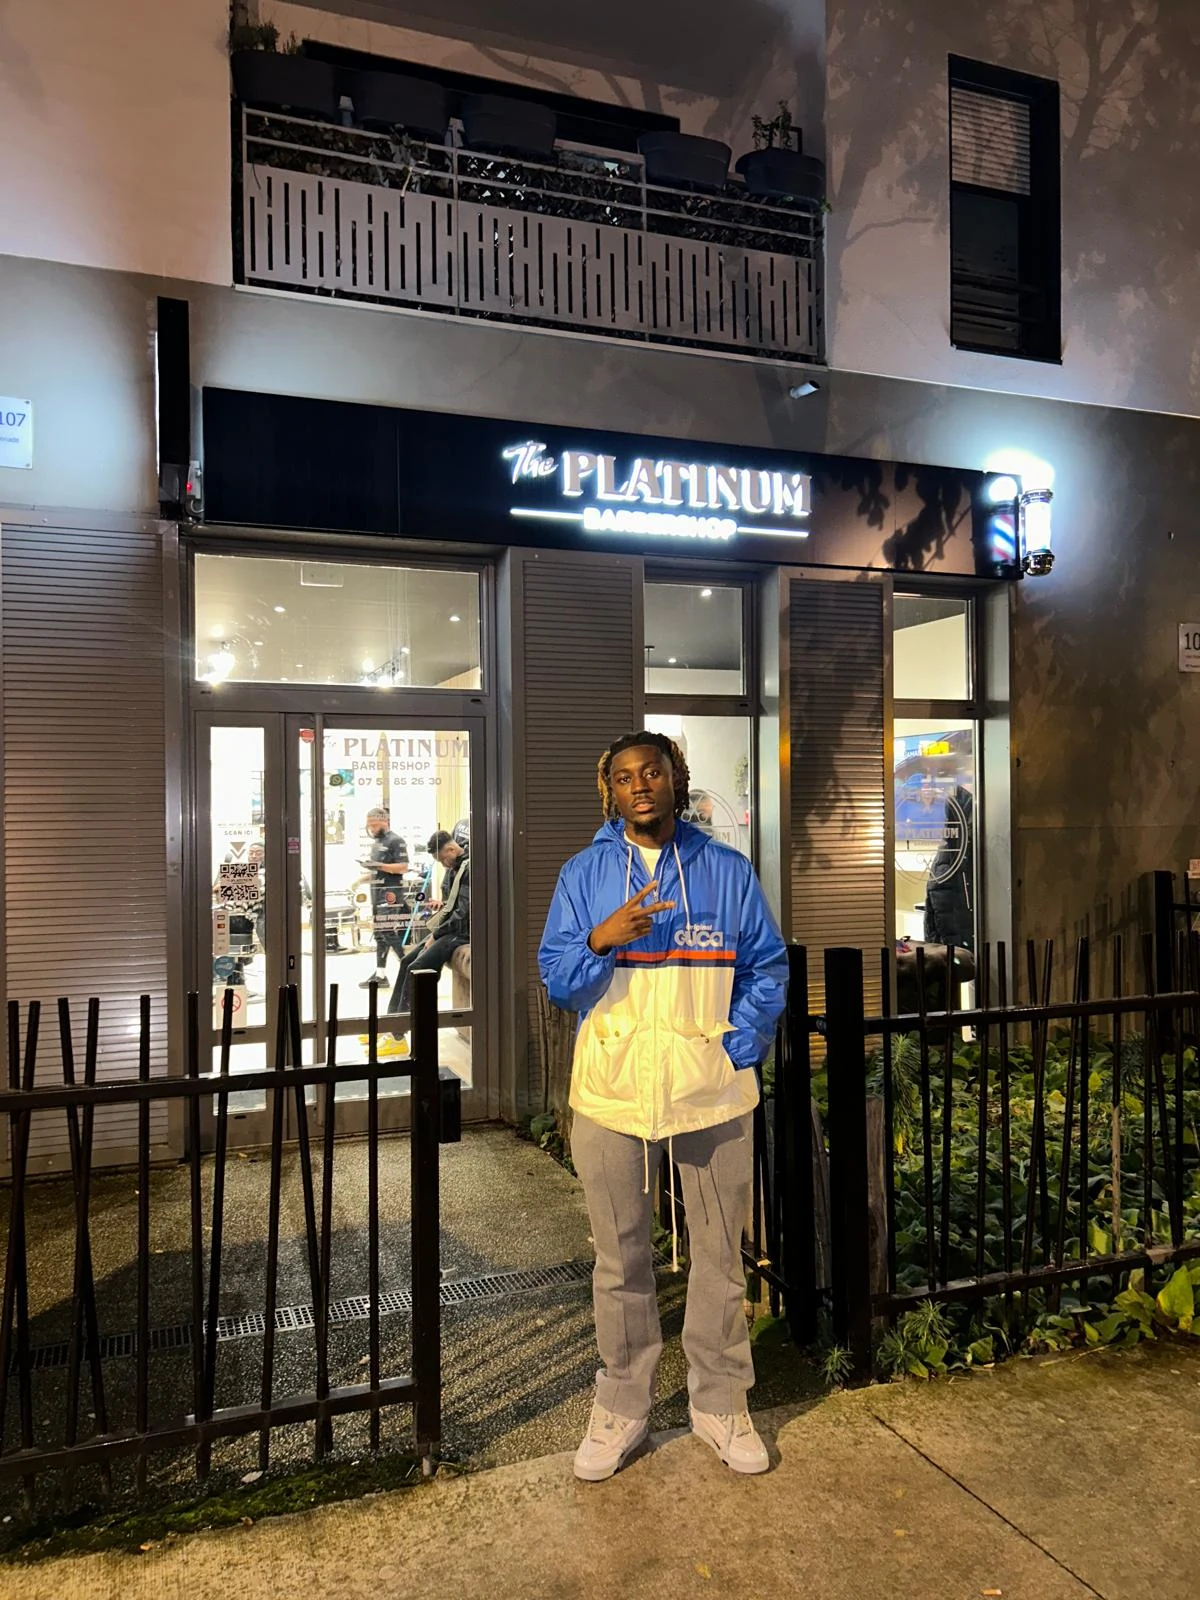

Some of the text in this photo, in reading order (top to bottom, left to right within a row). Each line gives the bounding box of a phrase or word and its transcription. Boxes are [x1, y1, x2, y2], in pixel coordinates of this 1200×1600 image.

[502, 439, 812, 516] The PLATINUM
[343, 737, 469, 759] PLATINUM
[352, 761, 431, 771] BARBERSHOP
[358, 777, 372, 786] 07
[394, 777, 408, 786] 85
[411, 777, 424, 786] 26
[428, 777, 442, 786] 30
